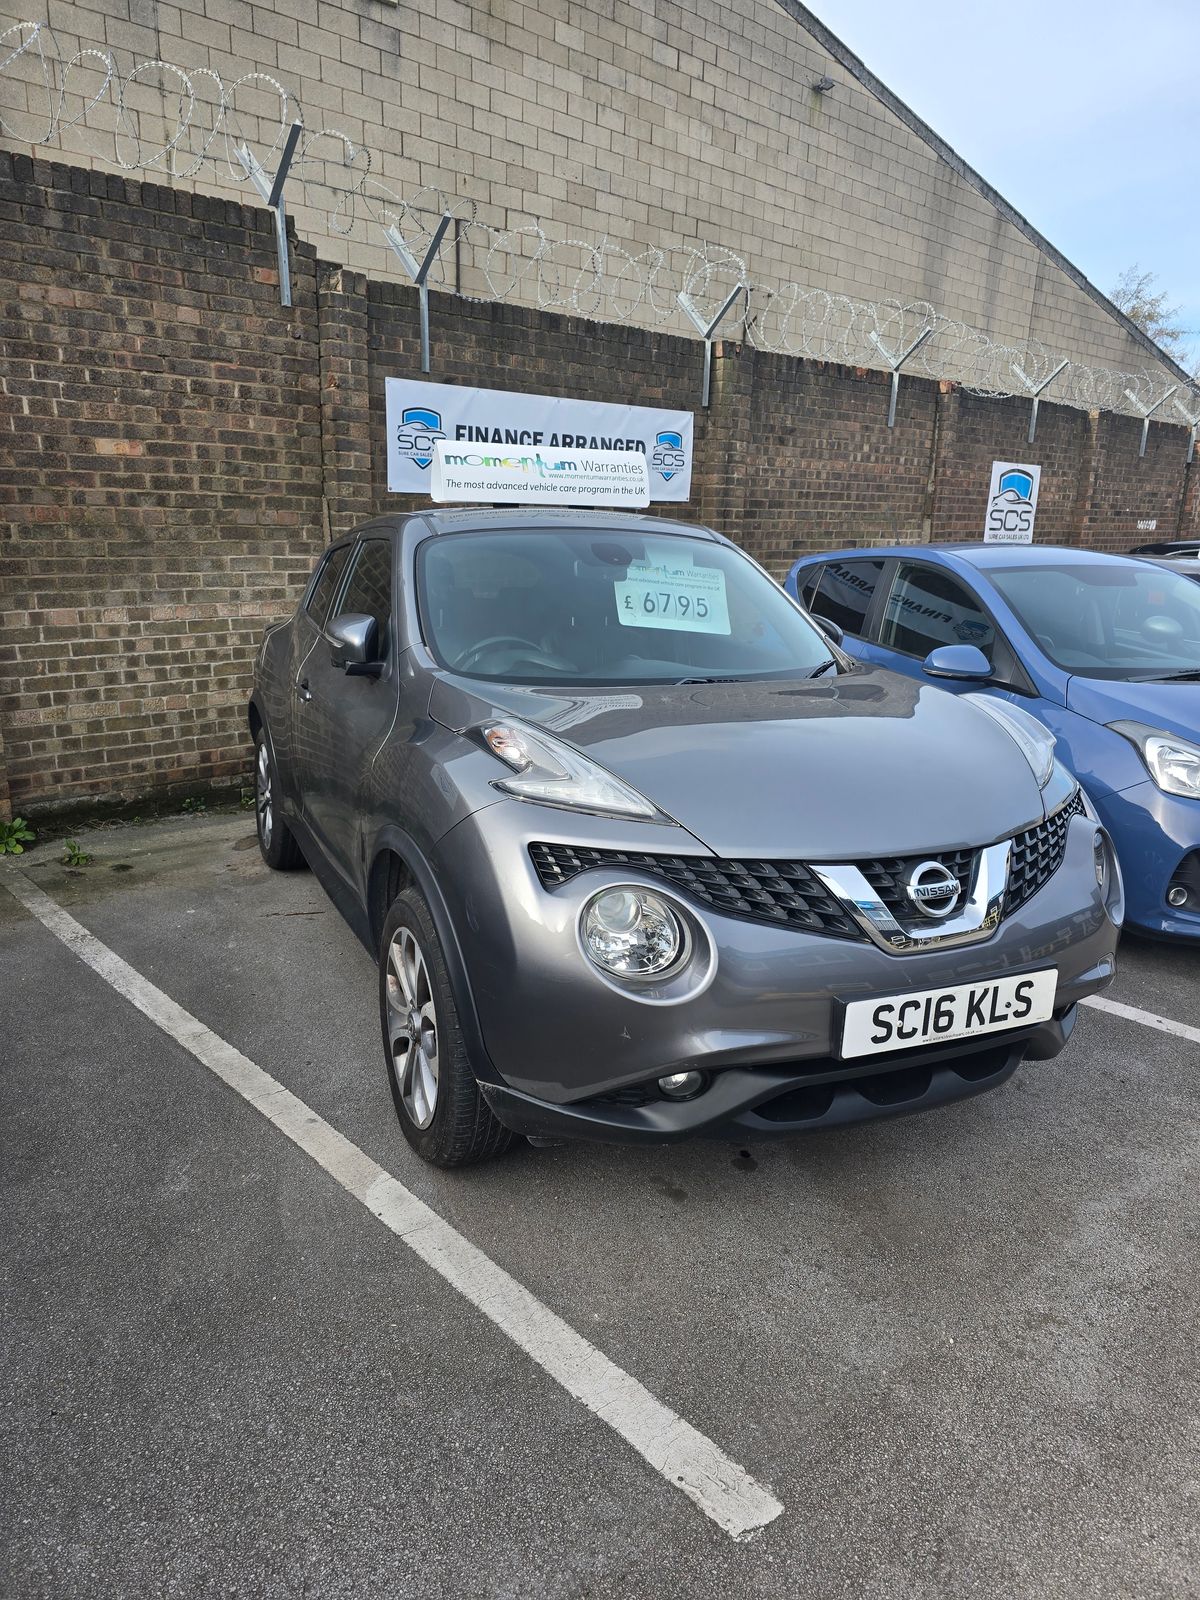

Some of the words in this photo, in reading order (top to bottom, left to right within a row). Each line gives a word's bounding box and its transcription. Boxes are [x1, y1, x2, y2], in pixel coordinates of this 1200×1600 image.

[456, 424, 544, 446] FINANCE
[549, 433, 647, 455] ARRANGED
[444, 453, 577, 478] momentum
[580, 460, 644, 475] Warranties
[652, 453, 685, 467] SCS
[446, 479, 462, 488] The
[463, 481, 485, 489] most
[486, 481, 529, 491] advanced
[529, 483, 558, 492] vehicle
[559, 484, 577, 492] care
[578, 486, 612, 495] program
[612, 486, 620, 494] in
[621, 487, 633, 495] the
[634, 487, 646, 495] UK
[988, 509, 1032, 531] SCS
[624, 595, 634, 609] £
[643, 592, 709, 618] 6795
[914, 882, 960, 898] NISSAN
[870, 994, 957, 1044] SC16
[965, 980, 1035, 1029] KLS
